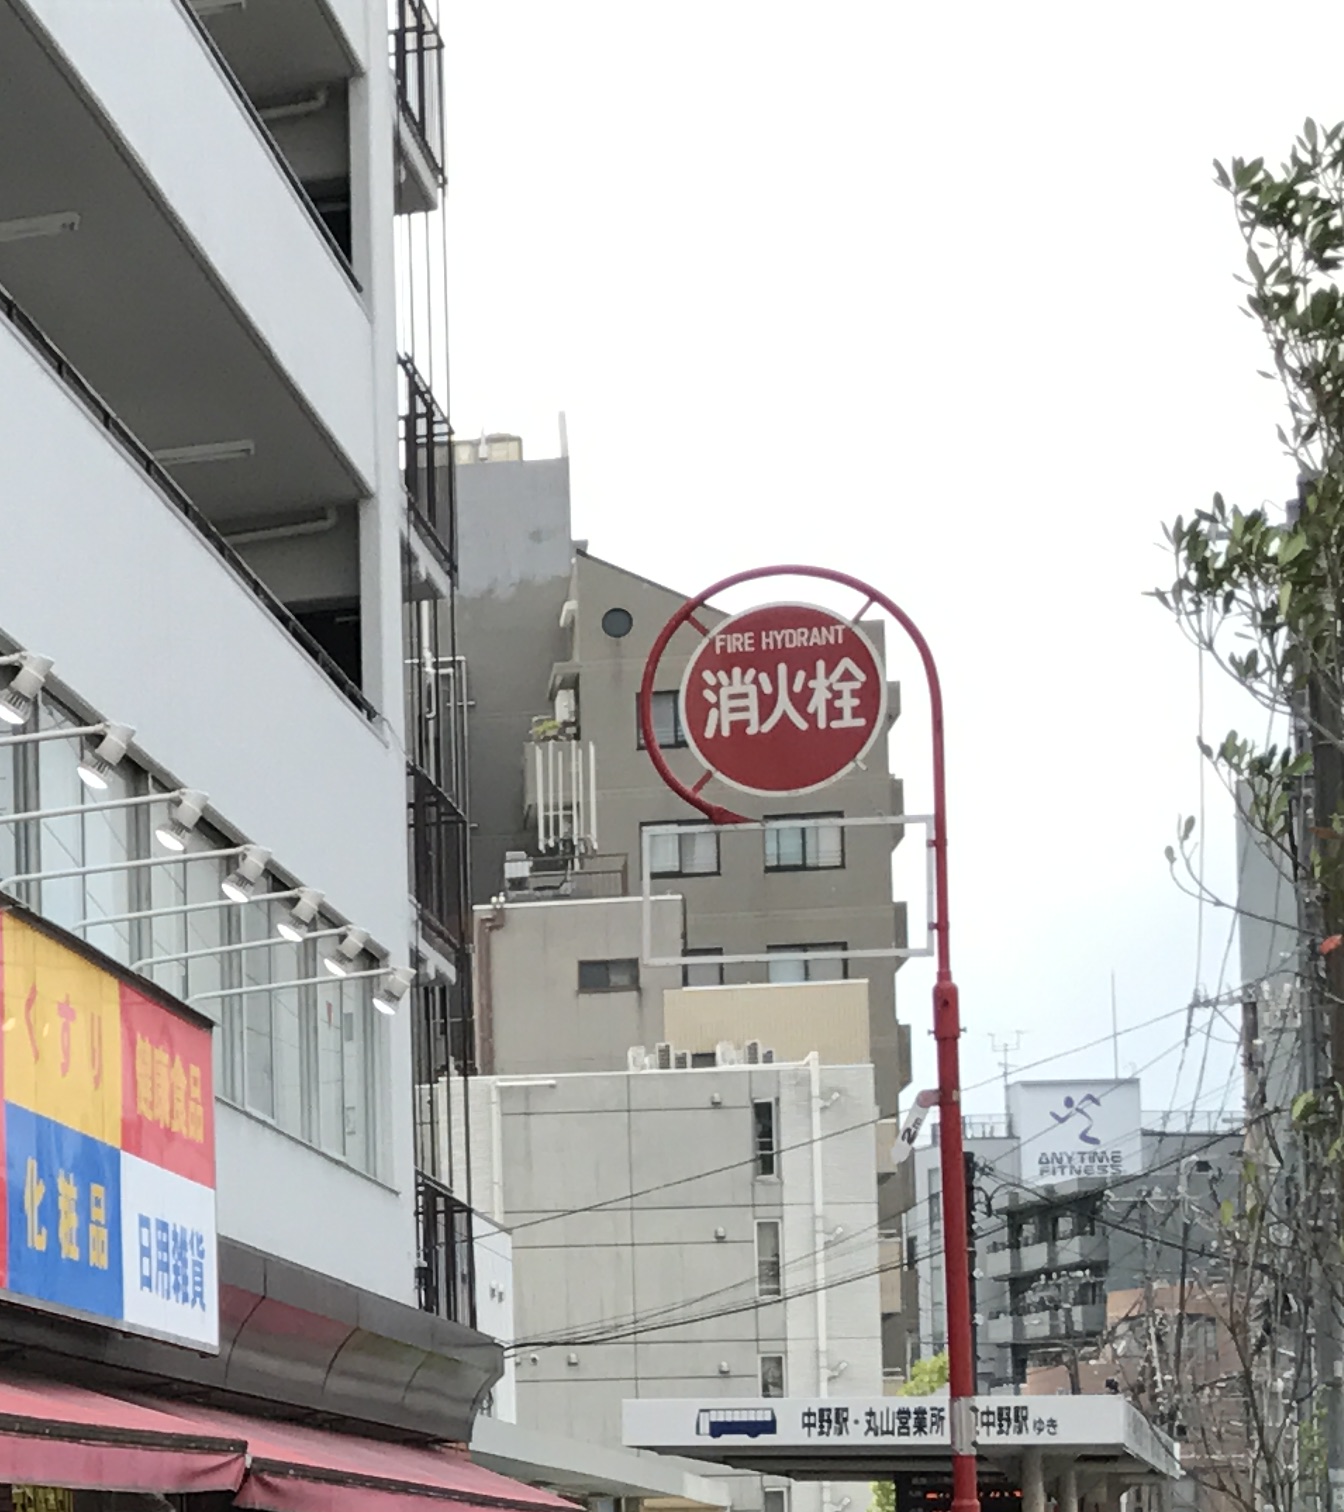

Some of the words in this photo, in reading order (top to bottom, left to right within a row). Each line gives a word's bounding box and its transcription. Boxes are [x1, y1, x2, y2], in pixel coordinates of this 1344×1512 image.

[715, 631, 755, 655] FIRE
[761, 625, 846, 651] HYDRANT
[702, 657, 867, 739] 消火栓
[24, 983, 102, 1091] くすり
[136, 1031, 204, 1144] 健康食品
[1038, 1150, 1122, 1164] ANYTIME
[1039, 1164, 1122, 1176] FITNESS
[24, 1156, 109, 1270] 化粧品
[138, 1213, 206, 1312] 日用雑貨
[1033, 1417, 1058, 1435] ゆき
